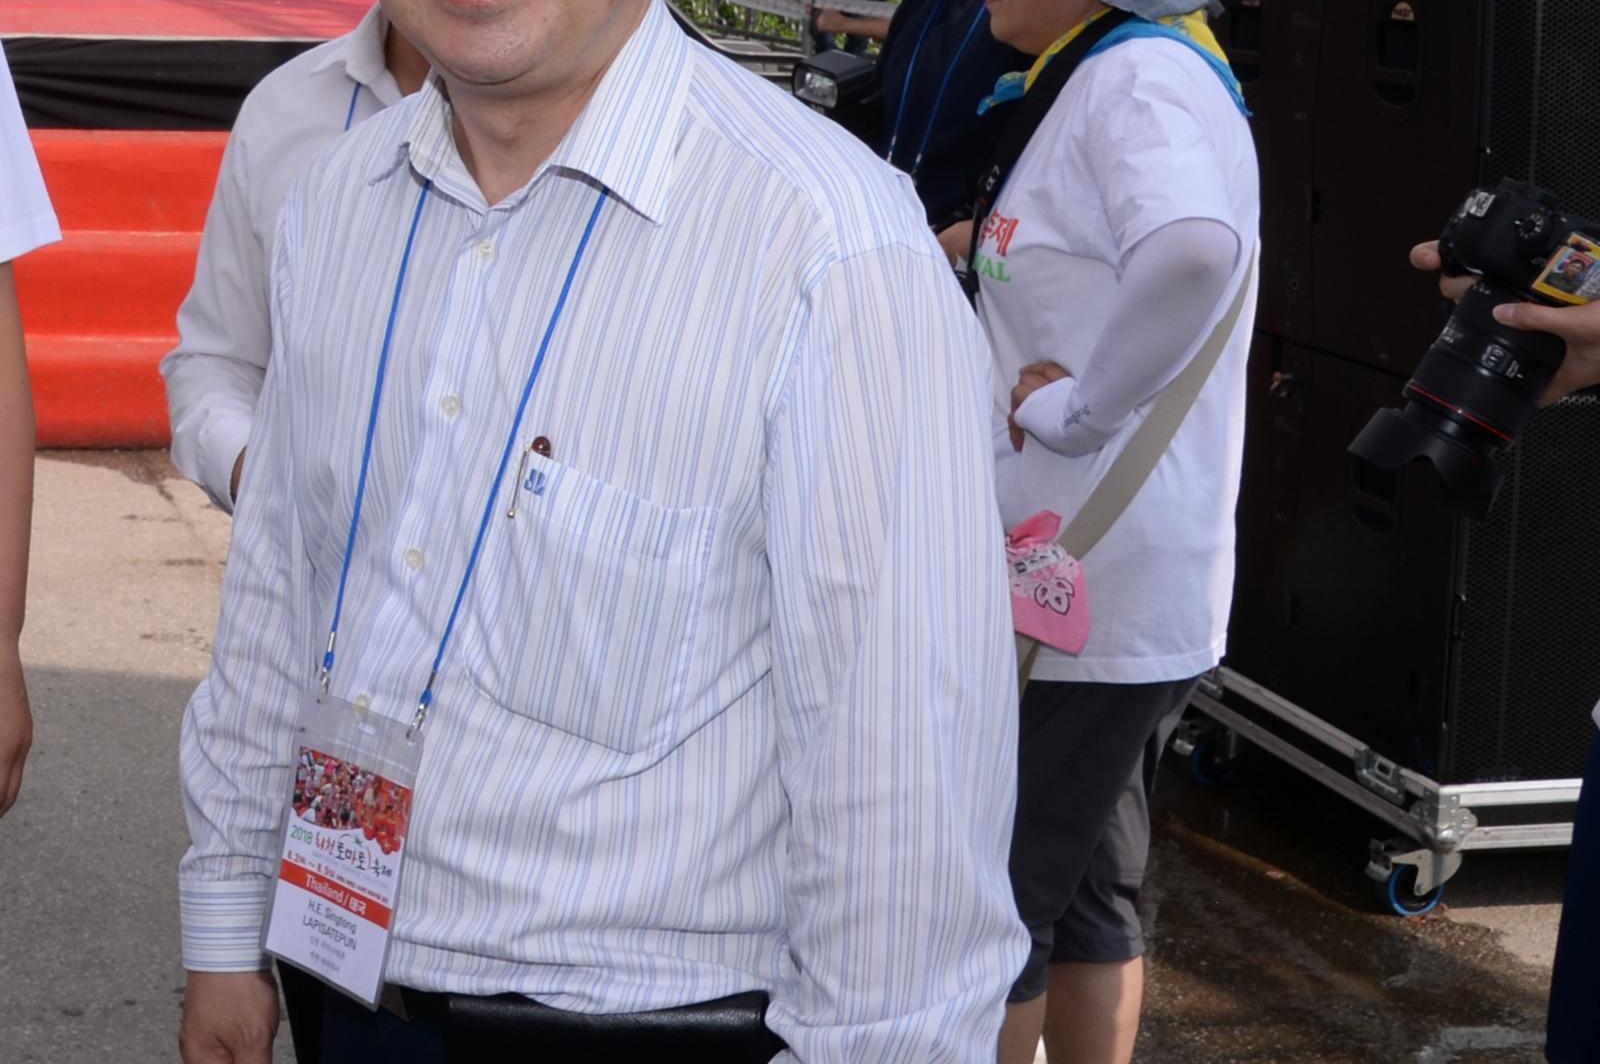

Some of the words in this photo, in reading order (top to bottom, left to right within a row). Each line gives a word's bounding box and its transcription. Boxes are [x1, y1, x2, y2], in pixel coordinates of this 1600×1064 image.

[291, 824, 313, 845] 2018
[336, 841, 366, 871] 토마토
[370, 857, 392, 878] 축제
[305, 873, 344, 904] Thailand
